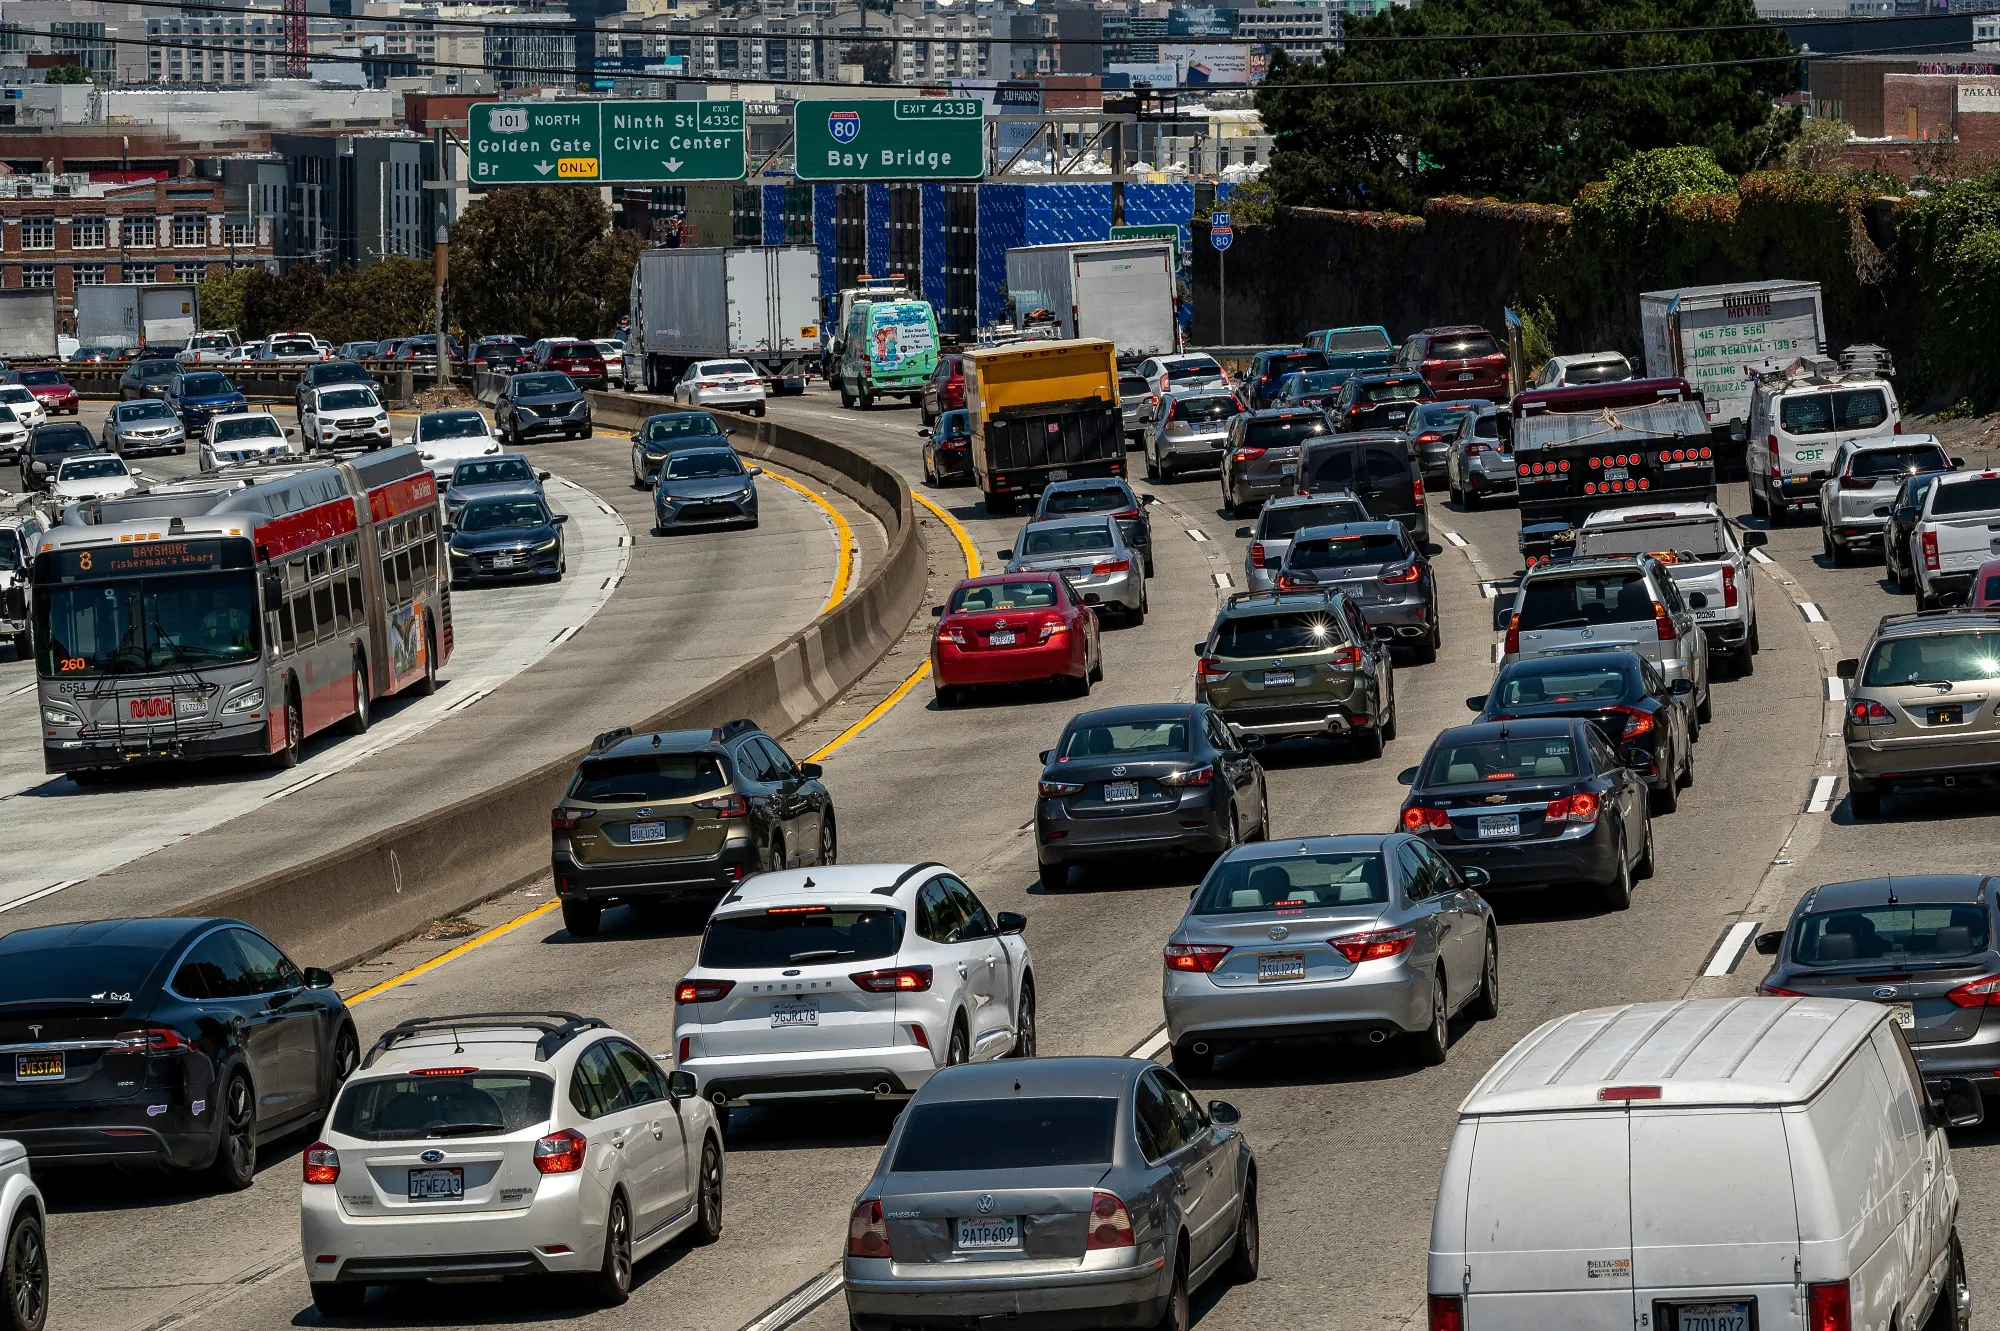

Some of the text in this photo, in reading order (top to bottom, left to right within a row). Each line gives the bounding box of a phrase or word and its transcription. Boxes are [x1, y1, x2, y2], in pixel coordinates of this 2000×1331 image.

[712, 105, 730, 113] EXIT
[902, 102, 976, 115] EXIT 433B
[498, 114, 519, 127] 101
[535, 115, 580, 126] NORTH
[614, 113, 694, 129] Ninth St
[702, 115, 739, 126] 433C
[834, 121, 855, 137] 80
[478, 138, 592, 153] Golden Gate
[613, 135, 731, 151] Civic Center
[827, 149, 952, 170] Bay Bridge
[478, 161, 499, 176] Br
[559, 161, 596, 173] ONLY
[1213, 214, 1229, 225] JCT
[1215, 236, 1229, 246] 80
[1727, 304, 1772, 319] MOVING
[1698, 323, 1766, 340] 415 756 5561
[1692, 347, 1717, 359] JUNK
[1721, 343, 1765, 356] REMOVAL
[1696, 365, 1736, 378] HAULING
[1795, 449, 1824, 461] CBF
[132, 543, 189, 558] BAYSHORE
[79, 551, 93, 571] 8
[111, 552, 214, 569] Fisherman's Wharf
[60, 657, 86, 671] 260
[59, 682, 87, 693] 6554
[780, 1001, 808, 1010] California
[774, 1009, 816, 1023] 9GJR178
[19, 1061, 62, 1075] EVESTAR
[419, 1171, 450, 1180] California
[412, 1178, 461, 1194] 7FWE213
[888, 1211, 921, 1219] PASSAT
[969, 1219, 1003, 1229] California
[962, 1226, 1014, 1244] 9ATP609
[1693, 1306, 1734, 1316] California
[1641, 1313, 1649, 1326] 5
